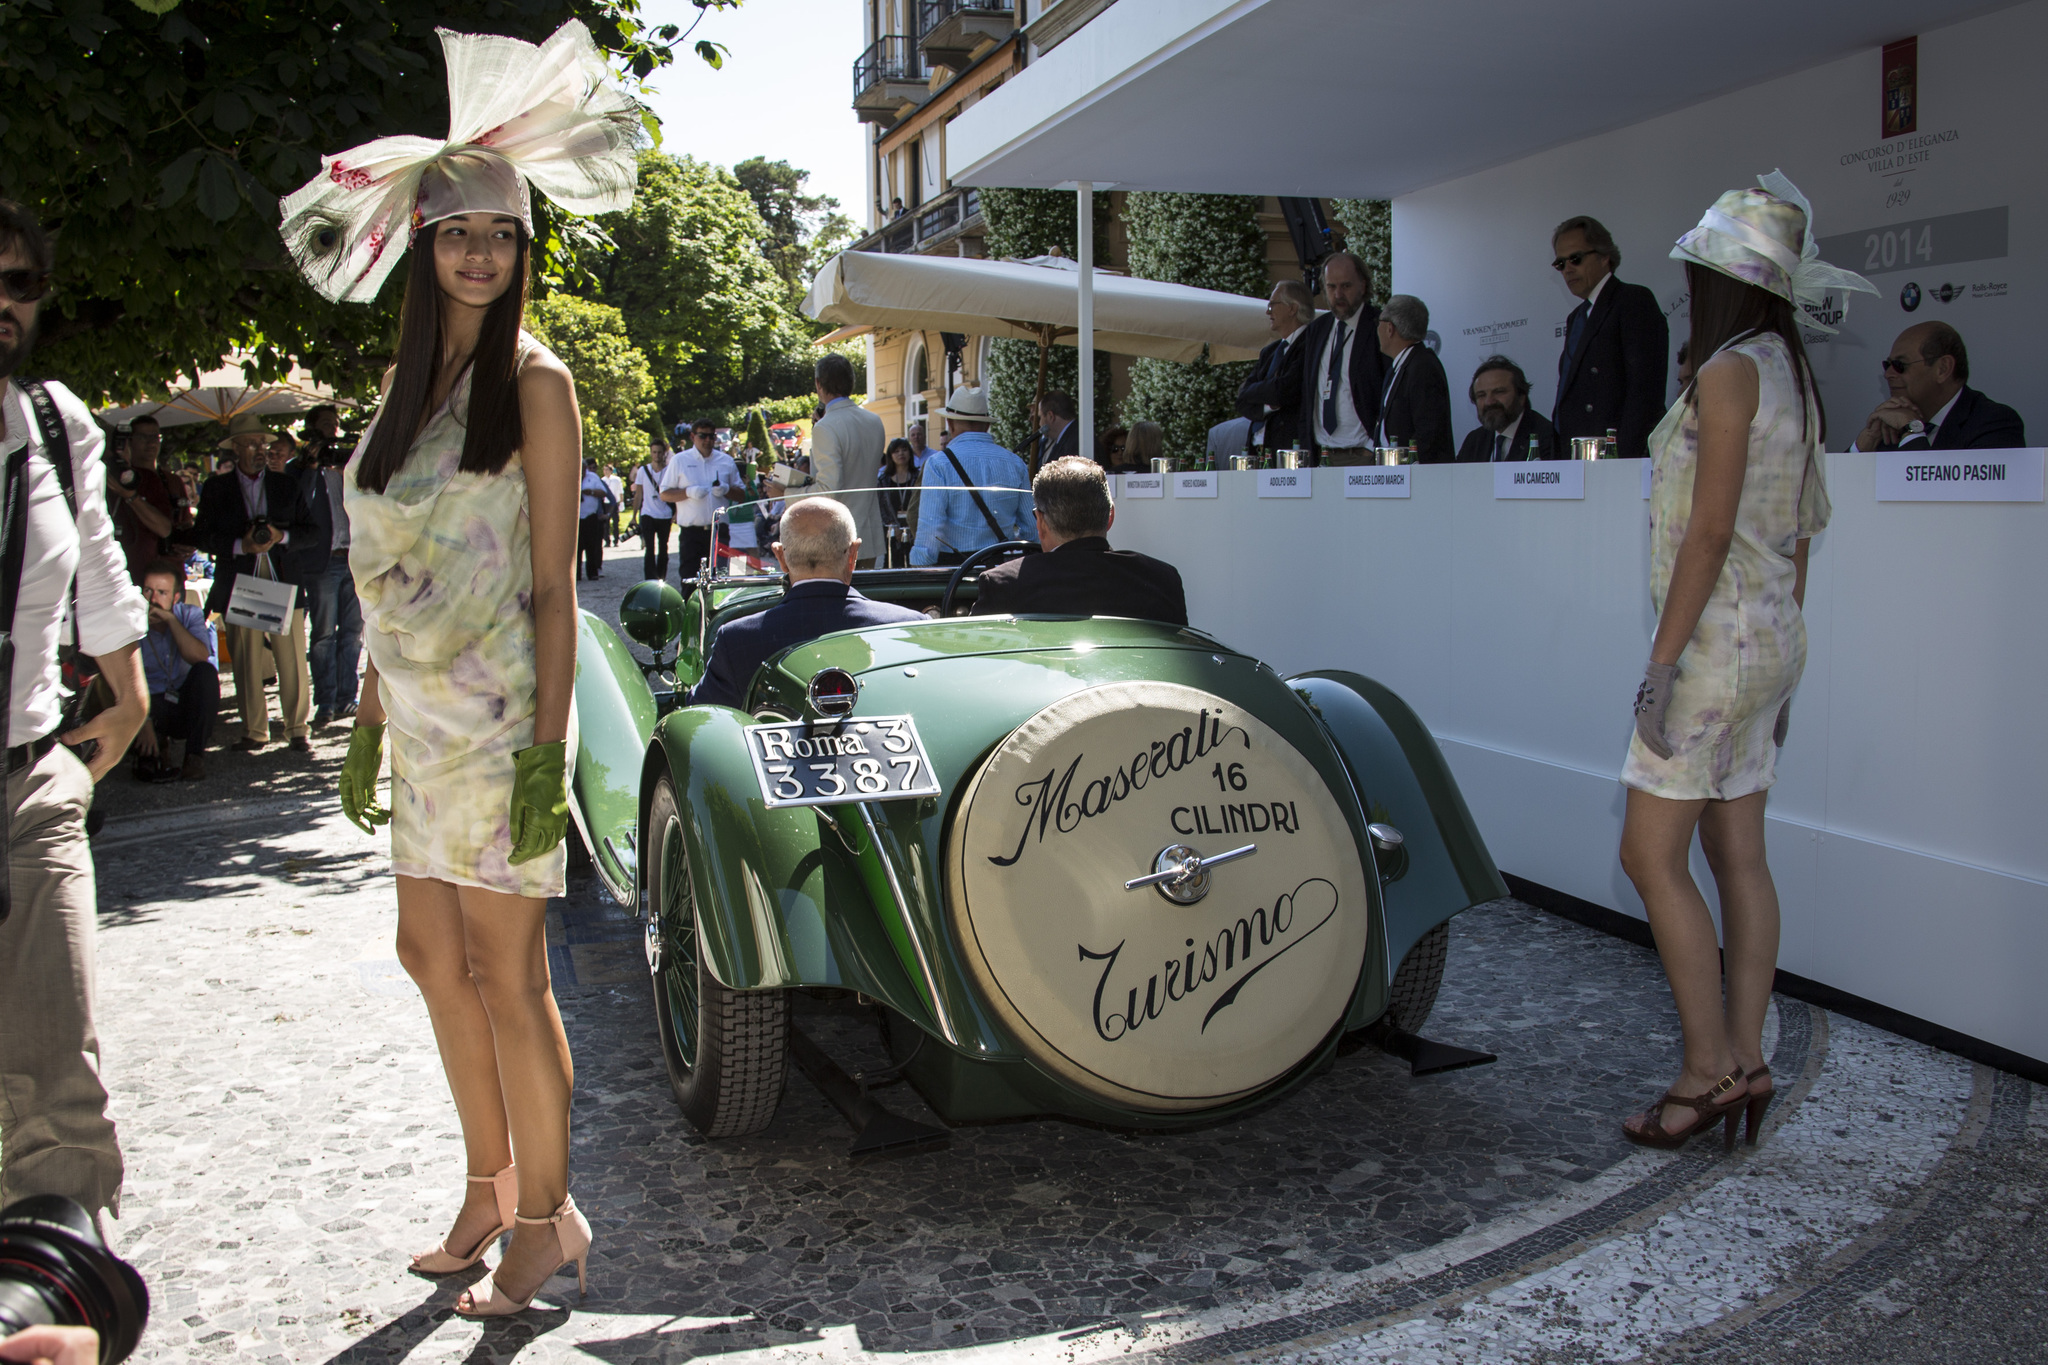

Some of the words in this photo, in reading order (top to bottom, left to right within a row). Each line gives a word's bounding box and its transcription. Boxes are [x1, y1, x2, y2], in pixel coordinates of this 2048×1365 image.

[1840, 143, 1894, 167] CONCORSO
[1896, 130, 1960, 153] D'ELEGANZA
[1868, 157, 1894, 173] VILLA
[1896, 149, 1930, 167] D'ESTE
[1886, 189, 1911, 209] 1929
[1864, 224, 1933, 271] 2014
[1971, 282, 2008, 292] Rolls-Royce
[1463, 325, 1492, 336] VRANKEN
[1497, 318, 1529, 331] POMMERY
[1803, 333, 1830, 345] Classic
[1269, 477, 1287, 487] ADOLFO
[1286, 476, 1297, 486] ORSI
[1348, 475, 1372, 486] CHARLES
[1372, 474, 1385, 486] LORD
[1385, 474, 1405, 486] MARCH
[1513, 472, 1526, 485] IAN
[1526, 472, 1561, 485] CAMERON
[1905, 465, 1961, 482] STEFANO
[1963, 464, 2006, 481] PASINI
[756, 728, 870, 762] Roma
[876, 720, 913, 753] 3
[767, 755, 921, 799] 3387
[987, 708, 1250, 866] Maserati
[1212, 762, 1248, 792] 16
[1170, 801, 1301, 835] CILINDRI
[1077, 878, 1339, 1042] Turismo
